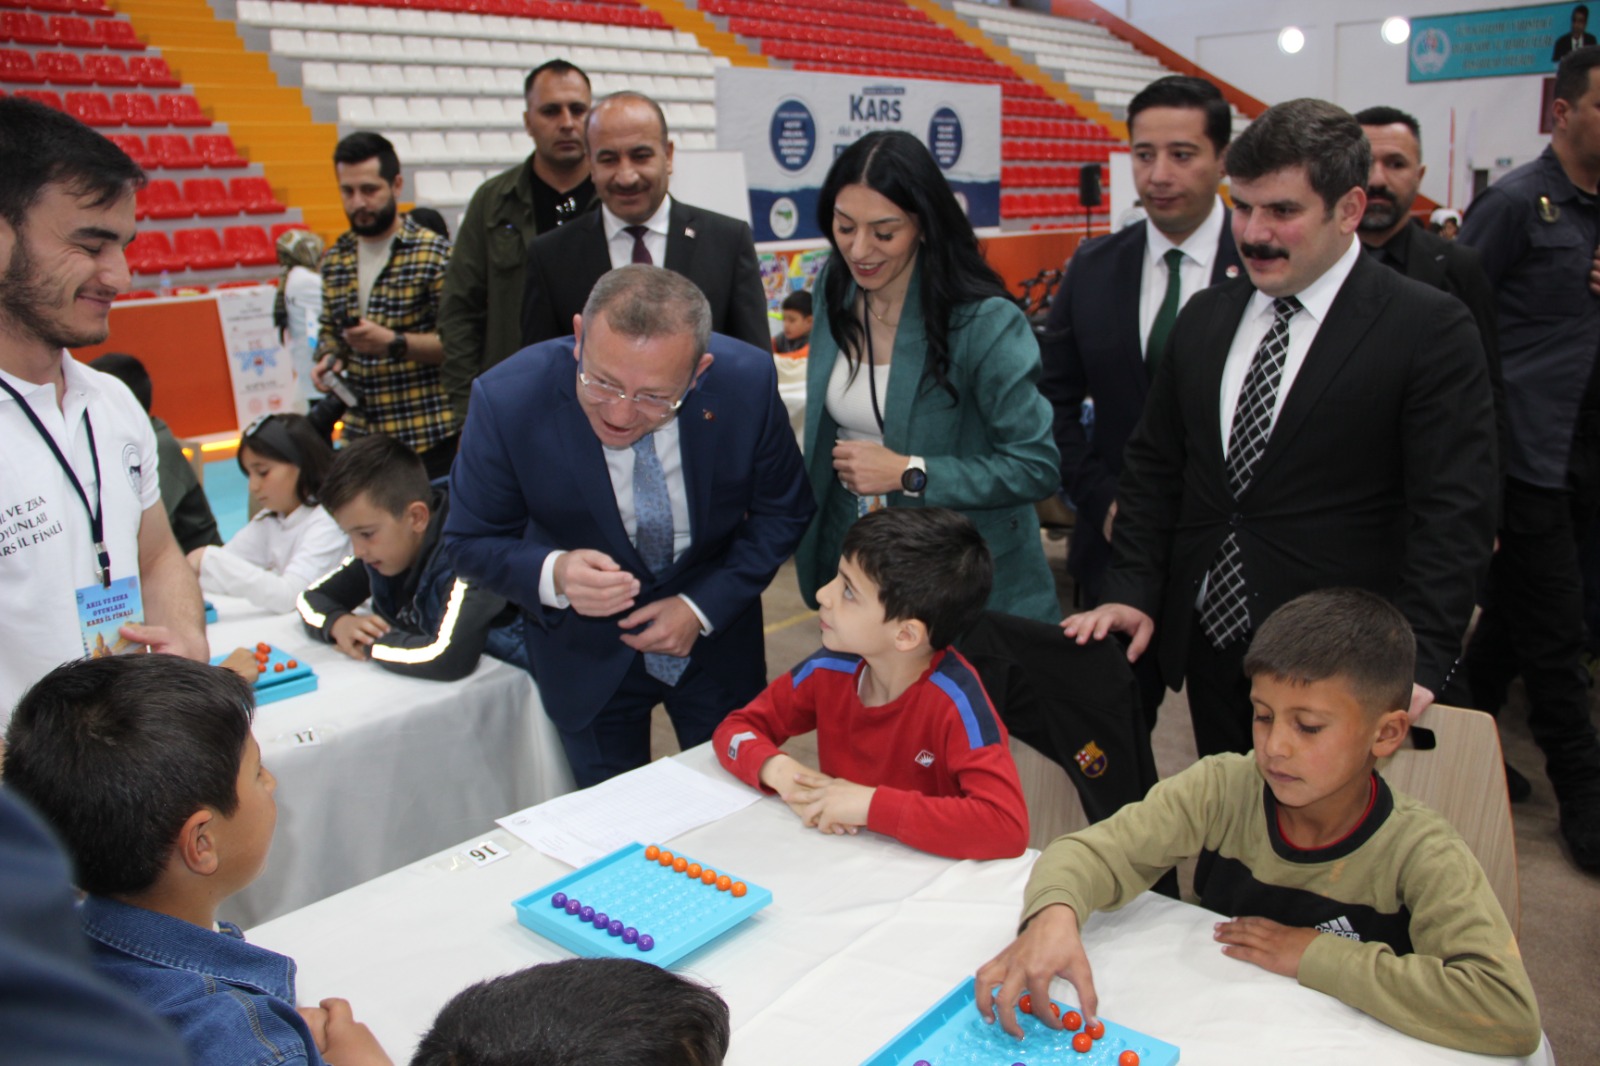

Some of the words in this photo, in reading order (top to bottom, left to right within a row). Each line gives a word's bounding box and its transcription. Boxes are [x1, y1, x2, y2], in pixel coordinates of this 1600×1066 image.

[849, 94, 902, 122] KARS
[6, 504, 23, 517] VE
[294, 730, 313, 743] 17
[469, 845, 498, 861] 16
